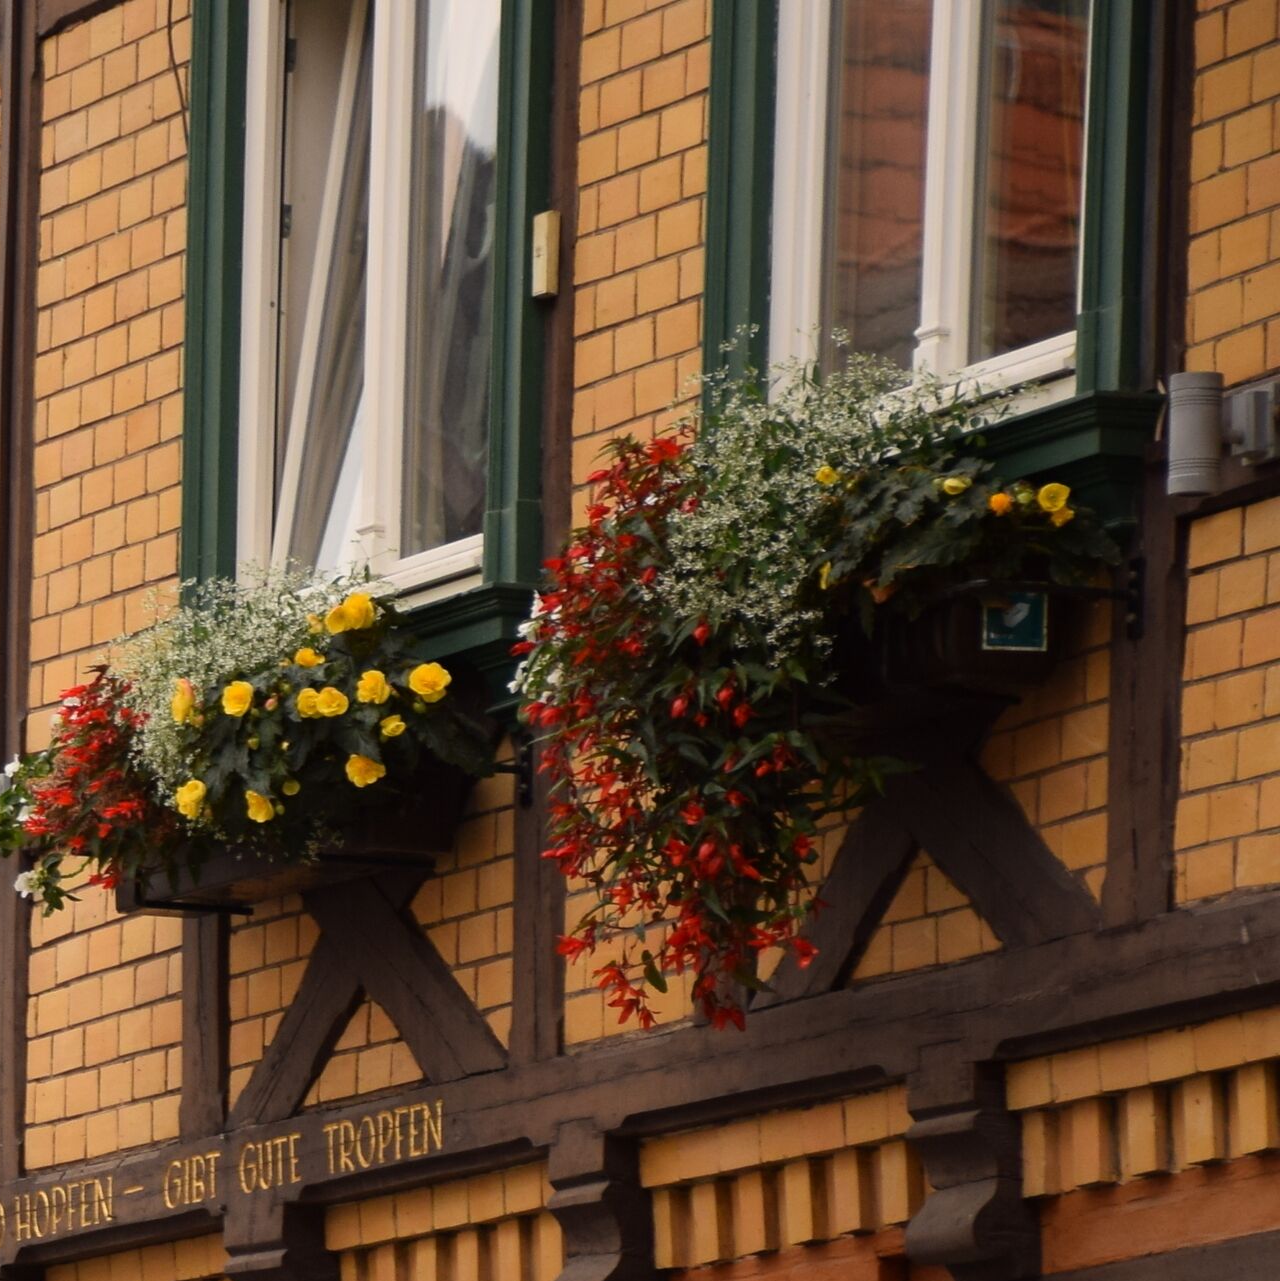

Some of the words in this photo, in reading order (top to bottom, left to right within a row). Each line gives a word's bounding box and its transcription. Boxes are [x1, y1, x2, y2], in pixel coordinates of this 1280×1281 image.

[15, 1176, 114, 1241] HOPFEN
[163, 1150, 221, 1209] GIBT
[240, 1132, 301, 1194] GUTE
[323, 1099, 444, 1175] TROPFEN
